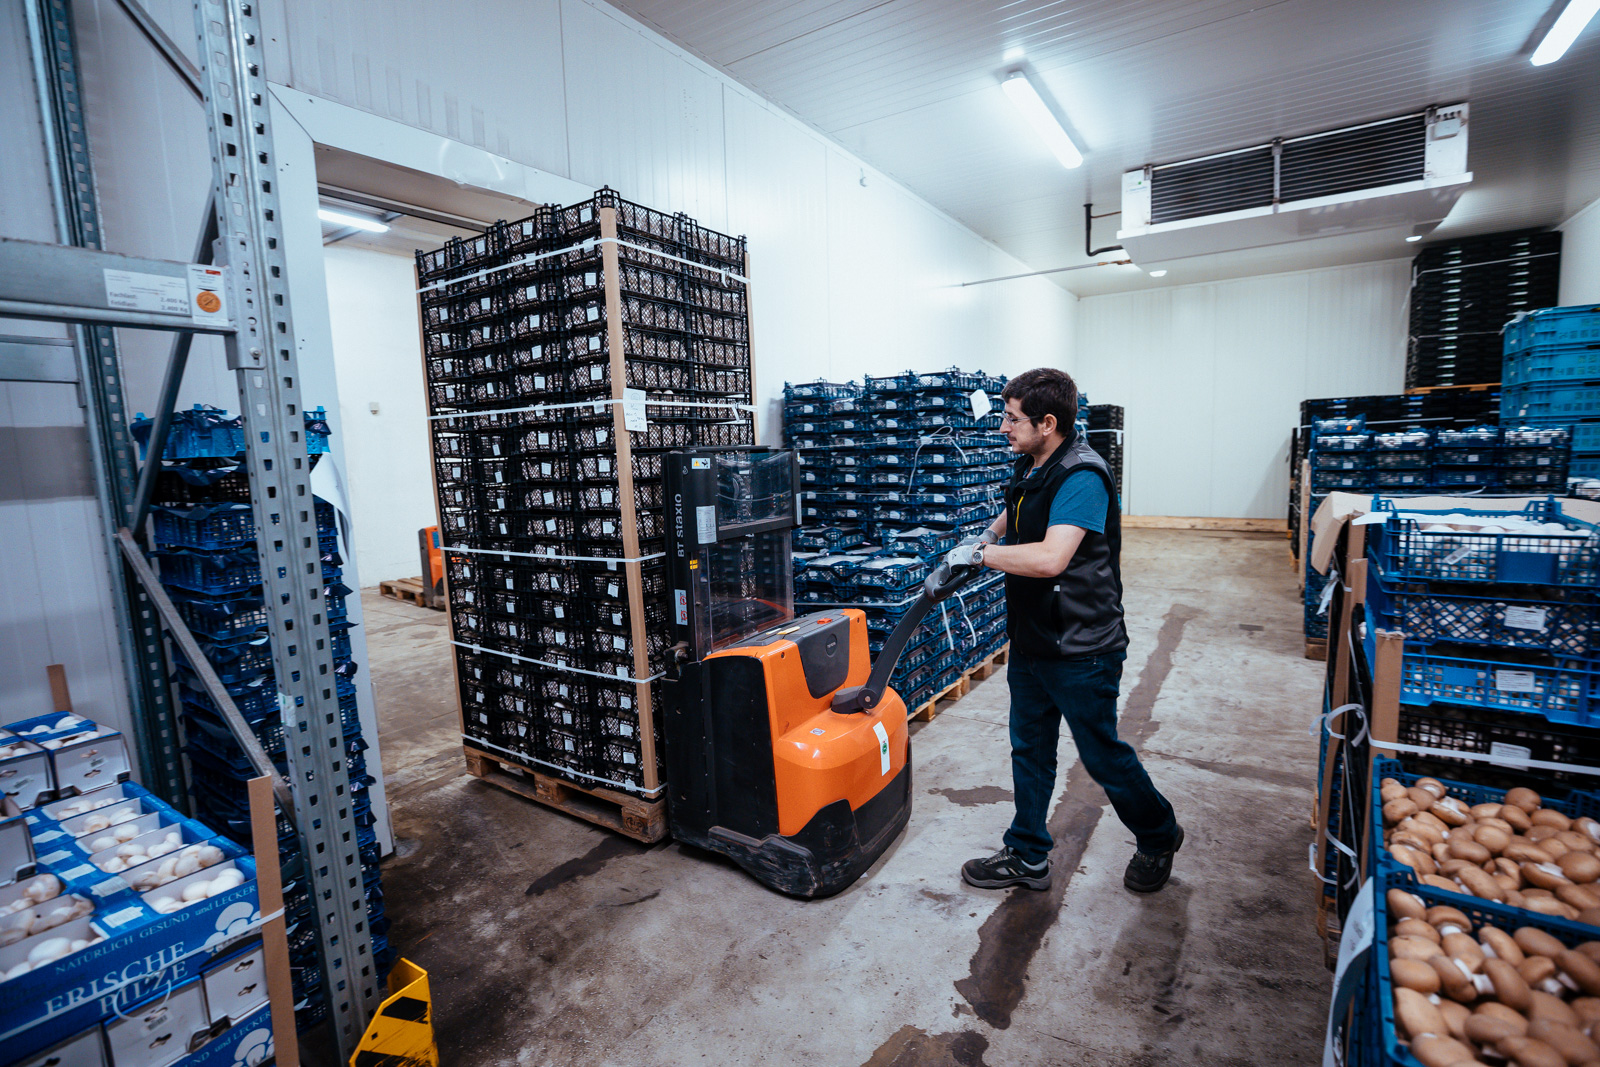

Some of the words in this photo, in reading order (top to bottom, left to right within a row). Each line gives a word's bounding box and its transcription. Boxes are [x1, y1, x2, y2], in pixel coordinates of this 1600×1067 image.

[677, 541, 685, 557] BT
[55, 935, 133, 975] NATÜRLICH
[140, 912, 190, 938] GESUND
[195, 903, 213, 916] und
[215, 885, 257, 908] LECKER
[44, 941, 186, 1016] FRISCHE
[99, 960, 188, 1016] PILZE
[214, 1036, 232, 1052] und
[233, 1010, 271, 1041] LECKER
